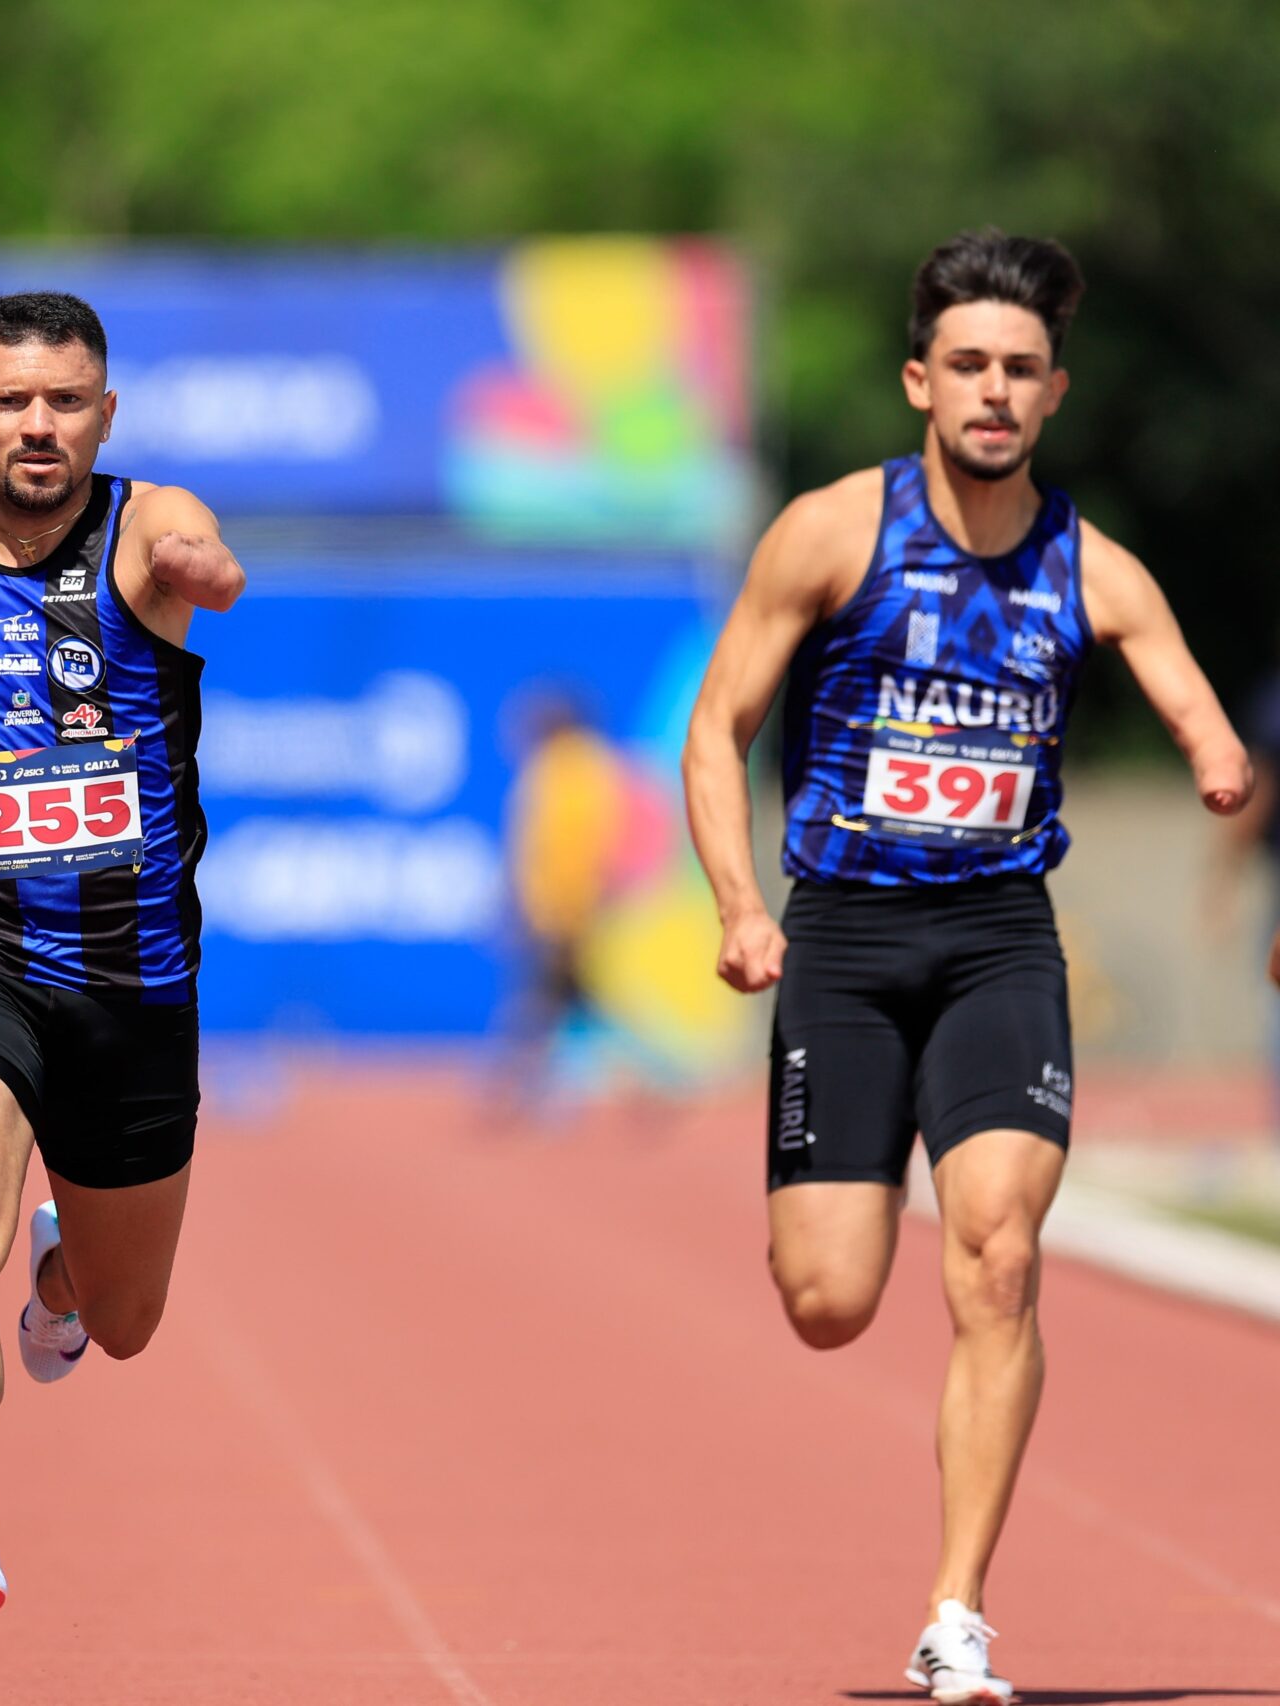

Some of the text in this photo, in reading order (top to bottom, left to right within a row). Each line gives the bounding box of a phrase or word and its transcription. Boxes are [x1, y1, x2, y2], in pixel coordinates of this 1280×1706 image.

[41, 592, 97, 603] PETROBRAS
[3, 622, 39, 633] BOLSA
[3, 632, 39, 641] ATLETA
[6, 709, 41, 719] GOVERNO
[4, 718, 13, 727] DA
[84, 759, 120, 771] CAIXA
[881, 758, 1019, 823] 391
